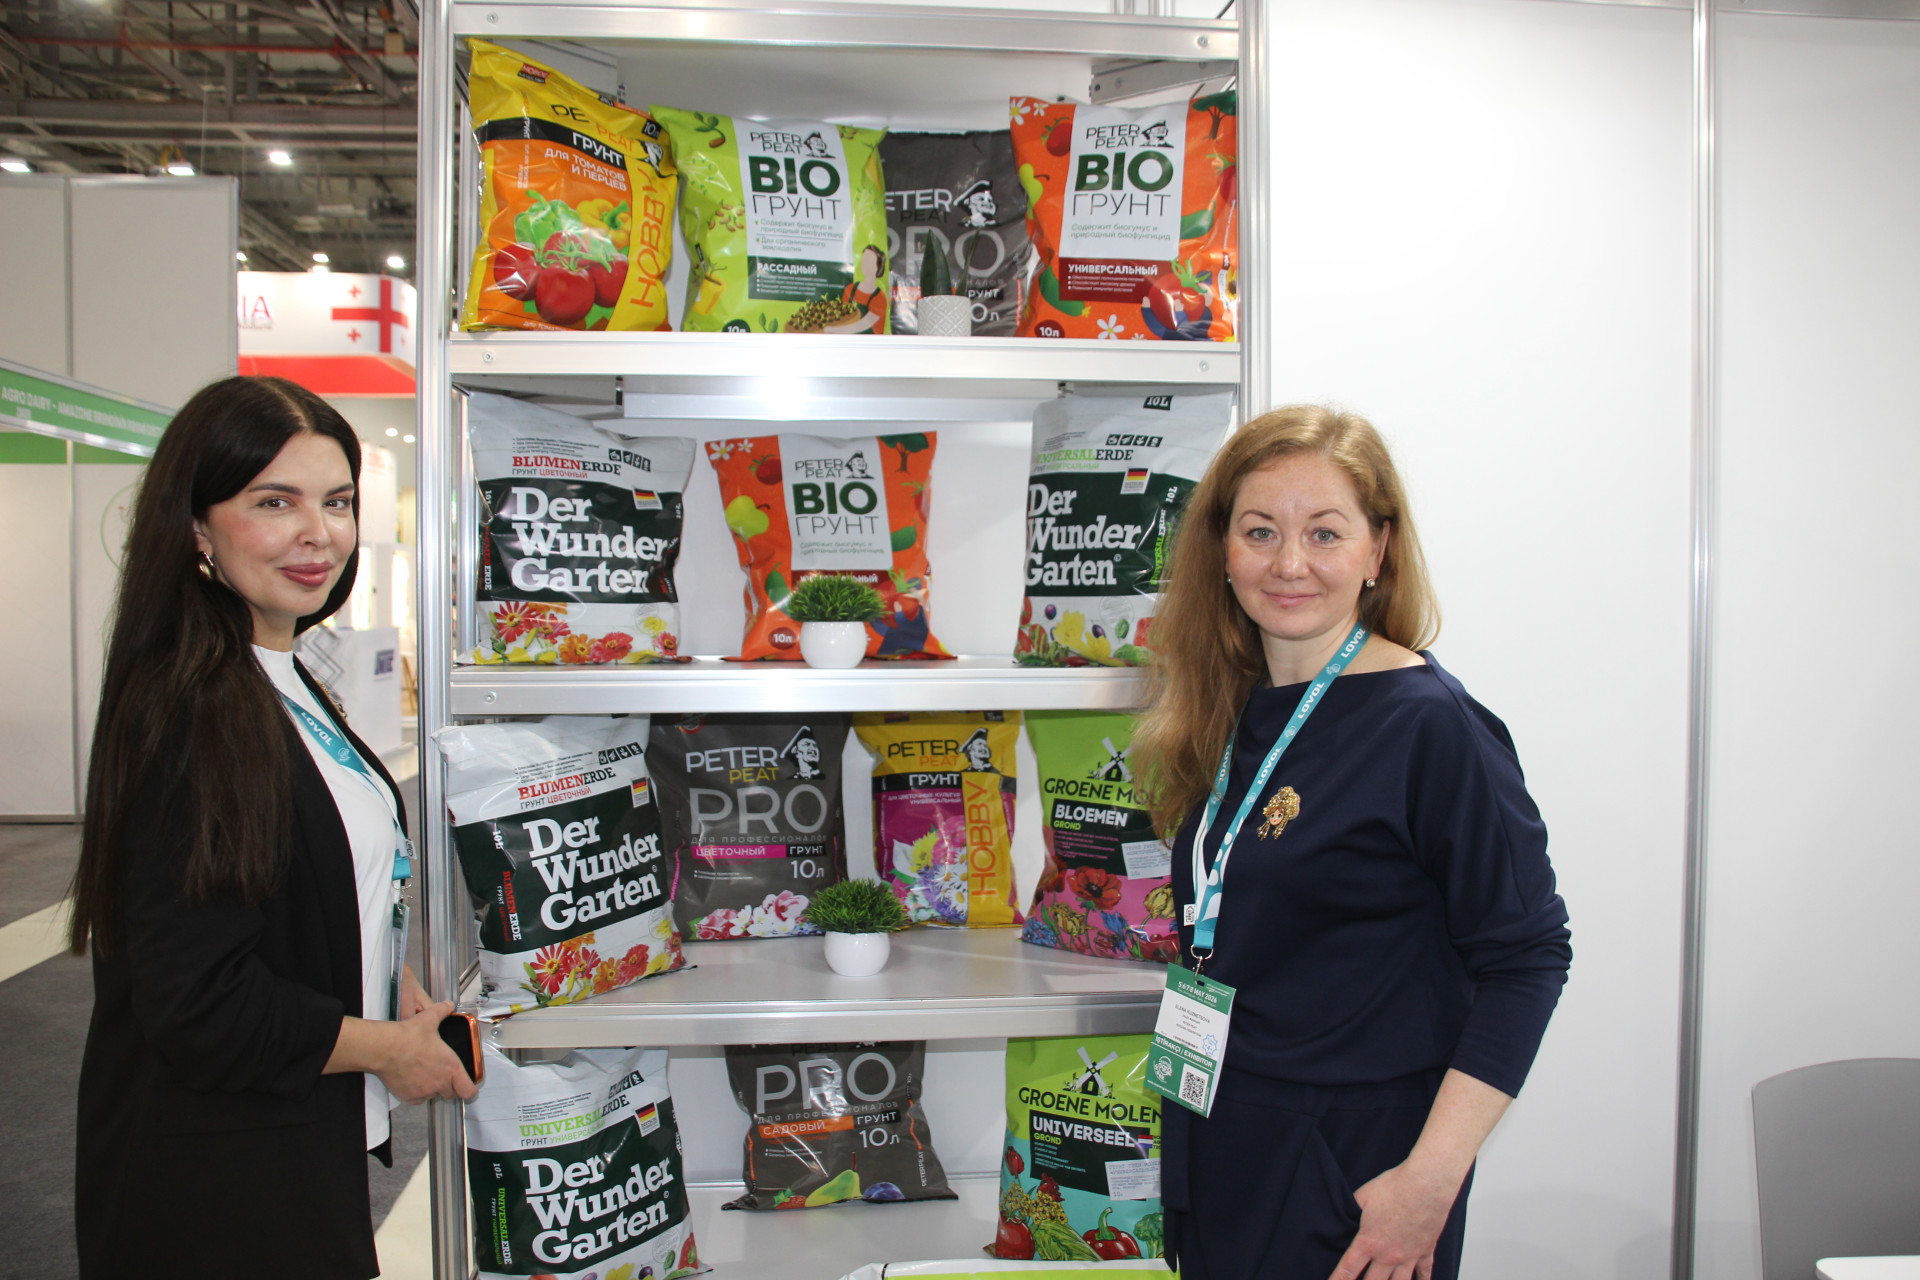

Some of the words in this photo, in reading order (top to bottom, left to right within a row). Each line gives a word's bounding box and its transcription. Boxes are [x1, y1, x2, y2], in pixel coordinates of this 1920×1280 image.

[750, 131, 802, 145] PETER
[1086, 124, 1140, 139] PETER
[1095, 136, 1136, 149] PEAT
[572, 132, 622, 167] ГРУНТ
[762, 142, 801, 154] PEAT
[545, 148, 569, 160] ДЛЯ
[572, 154, 625, 182] ТОМАТОВ
[571, 164, 581, 174] И
[582, 169, 627, 191] ПЕРЦЕВ
[748, 155, 840, 197] BIO
[1075, 150, 1174, 192] BIO
[752, 194, 842, 220] ГРУНТ
[885, 188, 953, 212] ETER
[1073, 193, 1171, 217] ГРУНТ
[757, 262, 817, 275] РАССАДНЫЙ
[1068, 264, 1158, 276] УНИВЕРСАЛЬНЫЙ
[968, 288, 1001, 299] РУНТ
[1039, 326, 1060, 338] 10л
[512, 456, 621, 475] BLUMENERDE
[512, 468, 538, 476] ГРУНТ
[539, 469, 588, 478] ЦВЕТОЧНЫЙ
[795, 458, 844, 471] PETER
[805, 468, 842, 479] PEAT
[511, 486, 592, 522] Der
[792, 481, 878, 515] BIO
[1029, 483, 1077, 516] Der
[1165, 486, 1178, 503] 10L
[795, 516, 879, 537] ГРУНТ
[1027, 515, 1141, 551] Wunder
[511, 522, 669, 562] Wunder
[511, 557, 650, 594] Garten
[1024, 552, 1117, 586] Garten
[773, 633, 792, 643] 10л
[1297, 680, 1325, 719] LOVOL
[301, 711, 333, 746] LOVOL
[685, 745, 779, 773] PETER
[888, 740, 960, 758] PETER
[920, 755, 960, 767] PEAT
[729, 767, 779, 784] PEAT
[1257, 746, 1283, 785] LOVOL
[518, 767, 616, 801] BLUMENERDE
[909, 773, 960, 786] ГРУНТ
[1044, 777, 1113, 801] GROENE
[520, 797, 546, 810] ГРУНТ
[547, 786, 592, 805] ЦВЕТОЧНЫЙ
[689, 783, 828, 835] PRO
[1053, 820, 1082, 831] GROND
[1055, 804, 1128, 827] BLOEMEN
[522, 815, 601, 858] Der
[965, 780, 996, 896] HOBBY
[532, 832, 661, 894] Wunder
[696, 846, 766, 857] ЦВЕТОЧНЫЙ
[790, 846, 823, 855] ГРУНТ
[503, 870, 522, 941] BLUMENERDE
[540, 871, 661, 932] Garten
[1183, 1049, 1213, 1068] EXHIBITOR
[756, 1053, 896, 1114] PRO
[1019, 1087, 1089, 1116] GROENE
[519, 1094, 630, 1137] UNIVERSALERDE
[763, 1119, 826, 1135] САДОВЫЙ
[857, 1111, 897, 1125] ГРУНТ
[521, 1137, 547, 1147] ГРУНТ
[1032, 1115, 1136, 1148] UNIVERSEEL
[1034, 1132, 1062, 1145] GROND
[522, 1154, 604, 1195] Der
[526, 1157, 674, 1230] Wunder
[498, 1188, 513, 1264] UNIVERSALERDE
[532, 1200, 669, 1264] Garten
